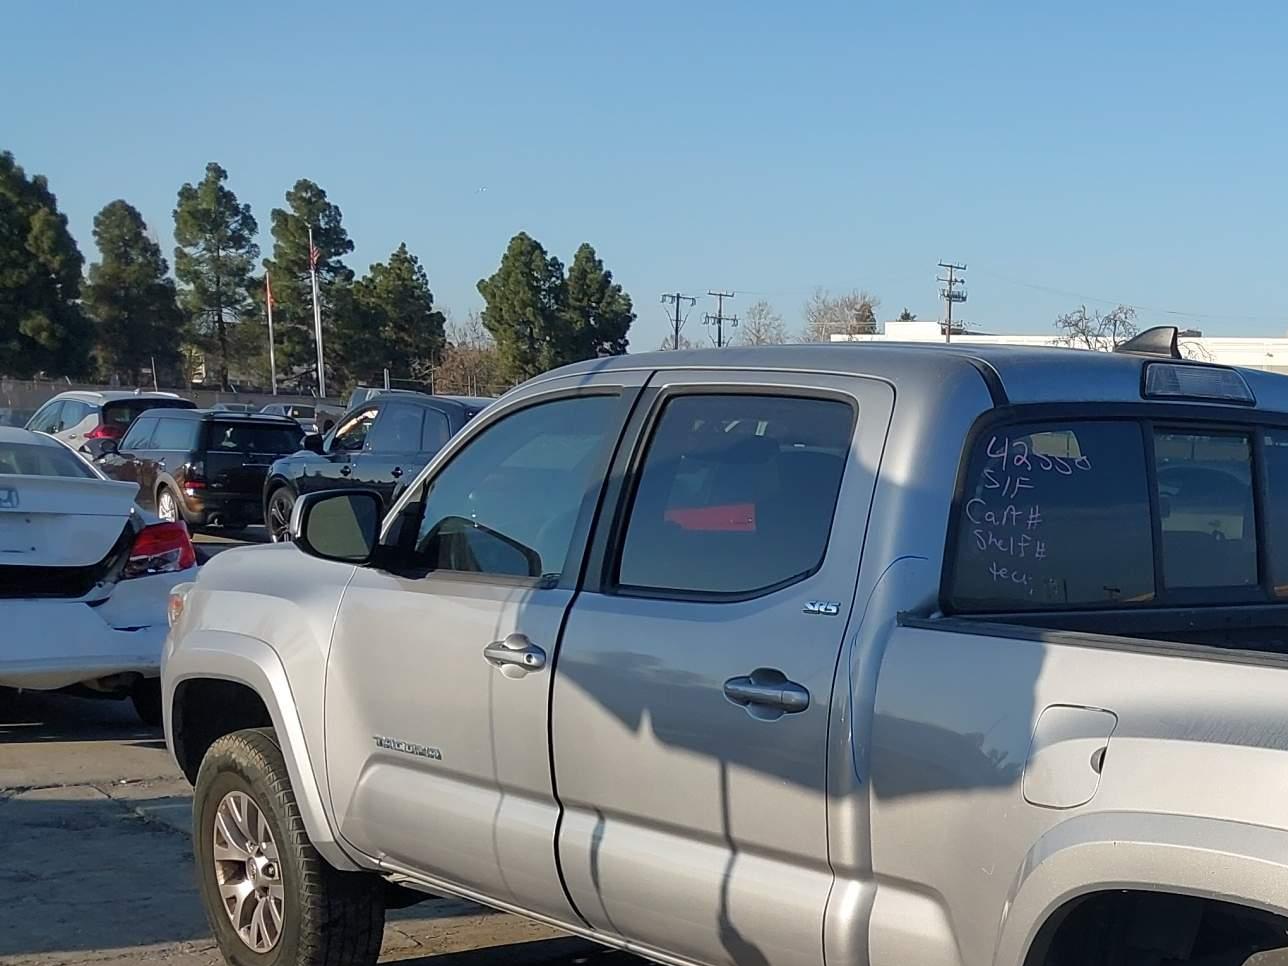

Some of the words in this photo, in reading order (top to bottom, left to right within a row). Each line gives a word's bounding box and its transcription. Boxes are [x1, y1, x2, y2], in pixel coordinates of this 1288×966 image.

[1026, 504, 1044, 530] #
[973, 529, 1032, 558] Shelf
[1034, 539, 1048, 561] #
